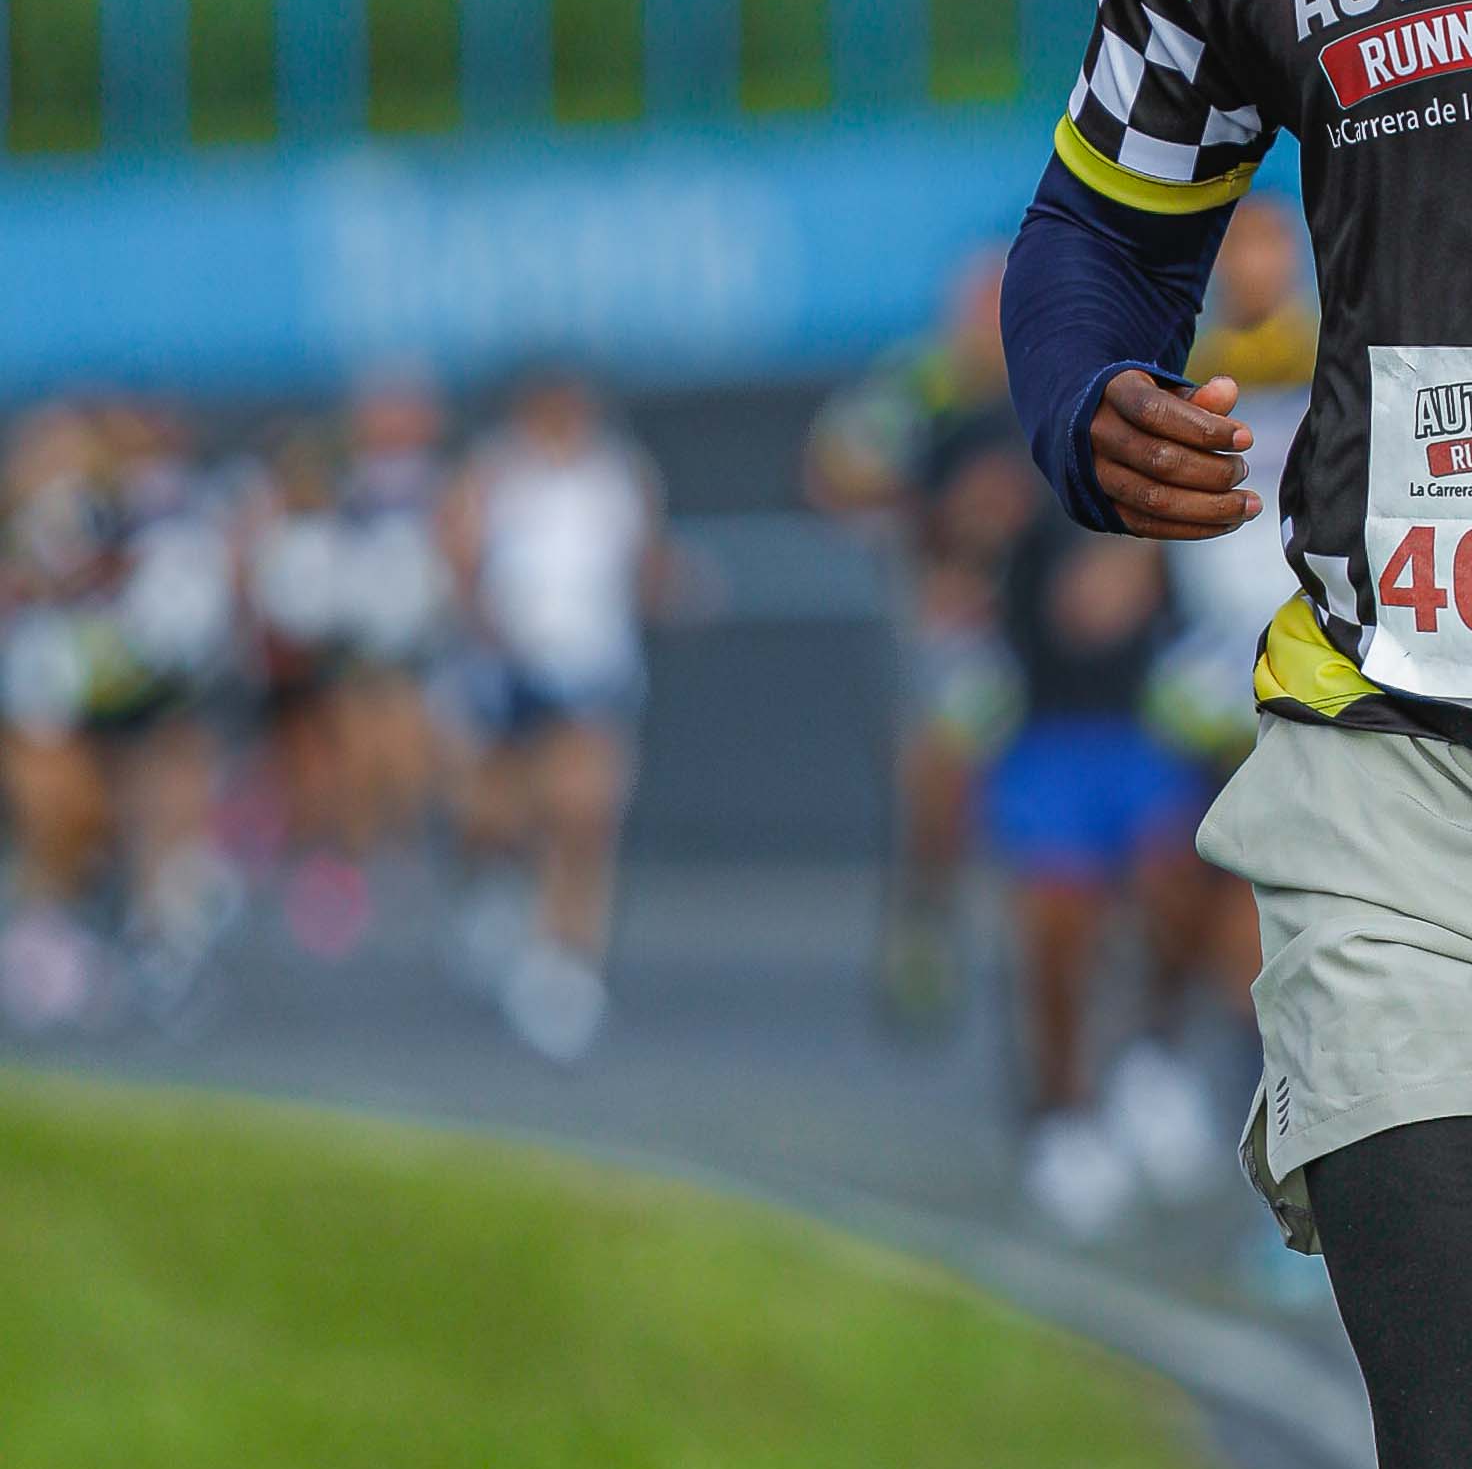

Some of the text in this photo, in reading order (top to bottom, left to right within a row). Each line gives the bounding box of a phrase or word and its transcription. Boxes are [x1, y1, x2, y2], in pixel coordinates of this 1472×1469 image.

[1341, 108, 1420, 145] Carrera
[1424, 97, 1457, 127] de
[1409, 481, 1425, 498] La
